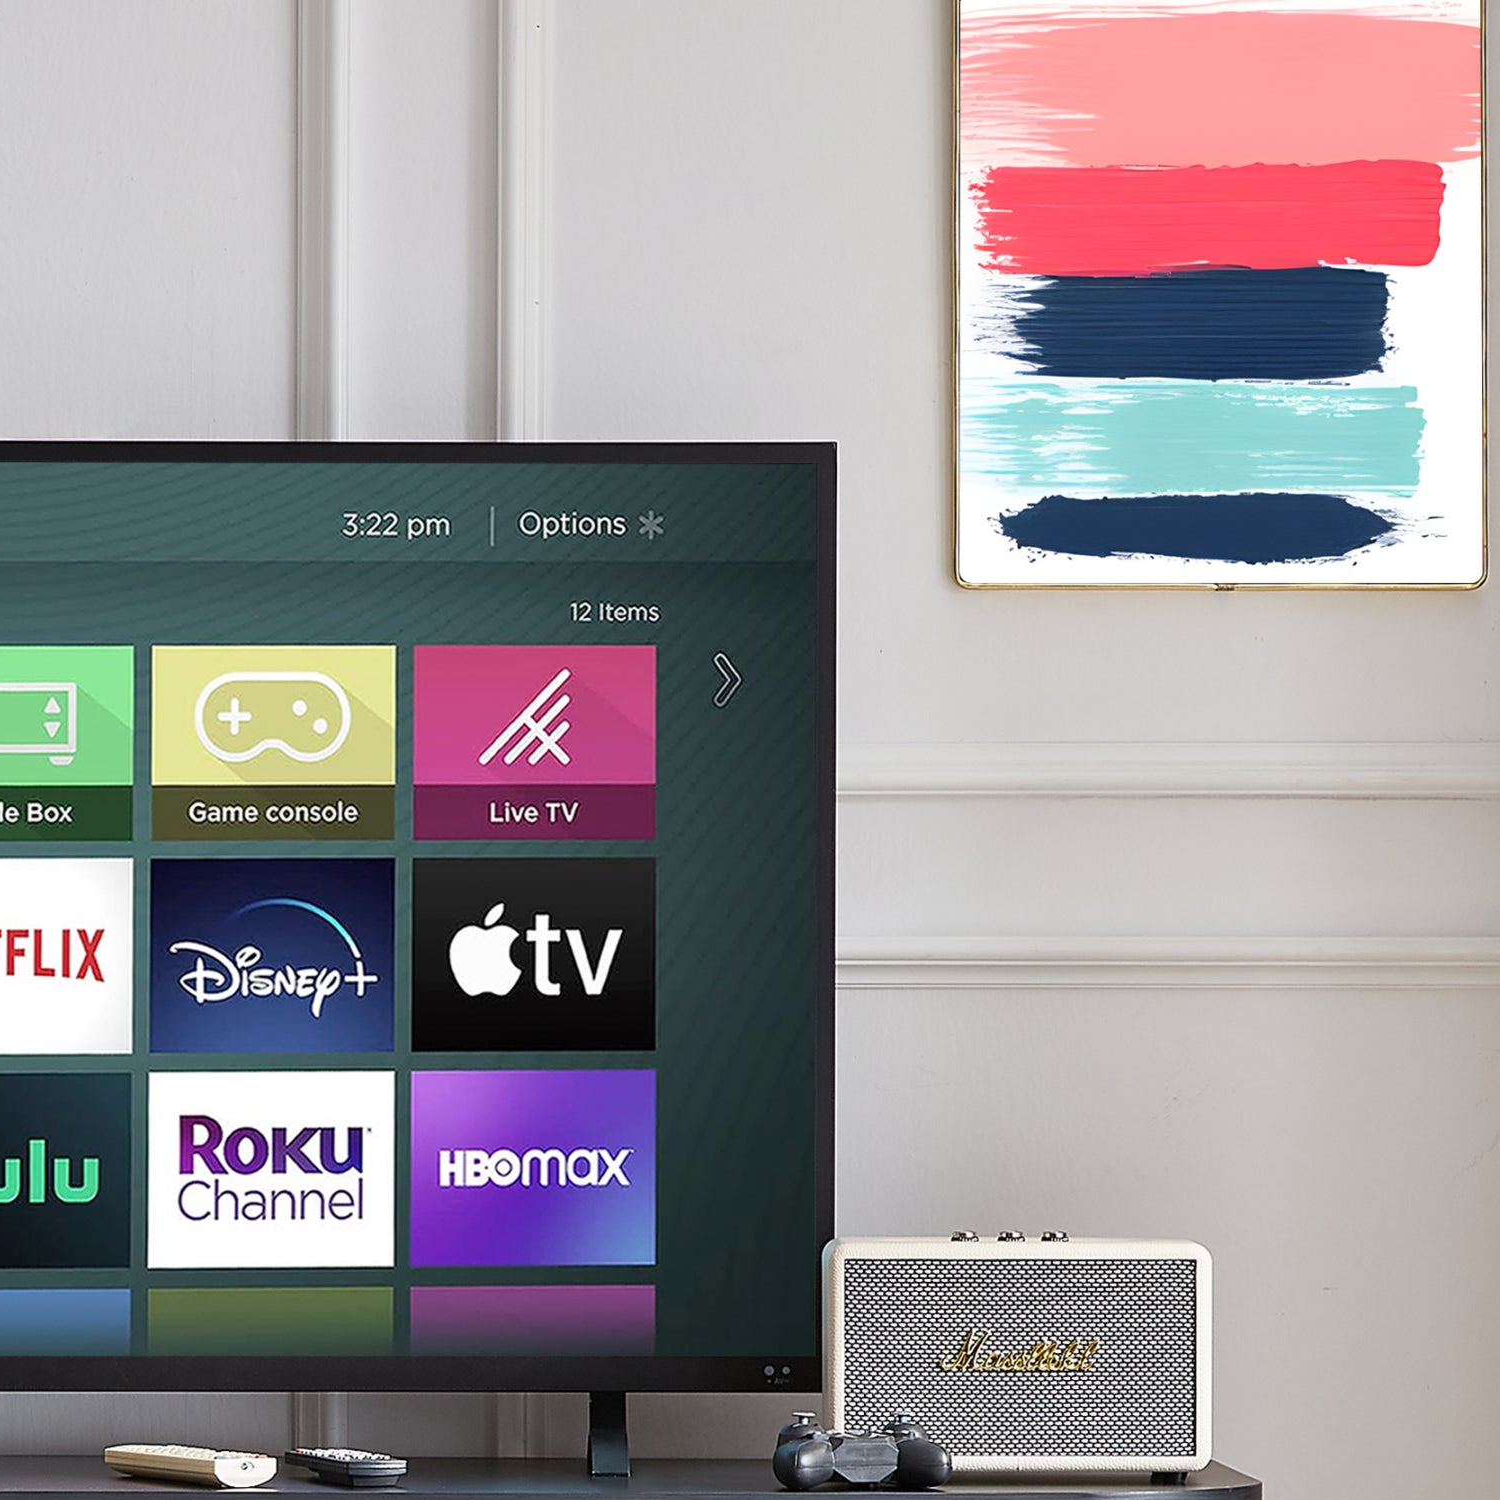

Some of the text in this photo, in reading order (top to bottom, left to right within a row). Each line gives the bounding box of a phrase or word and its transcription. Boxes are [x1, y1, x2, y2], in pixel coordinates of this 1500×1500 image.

[341, 511, 451, 541] 3:22 pm
[518, 510, 627, 541] Options
[569, 601, 661, 623] 12 Items
[26, 800, 74, 824] Box
[187, 799, 360, 824] Game console
[489, 800, 580, 824] Live TV
[526, 913, 624, 997] tv
[178, 1113, 364, 1176] Roku
[177, 1179, 364, 1222] Channel
